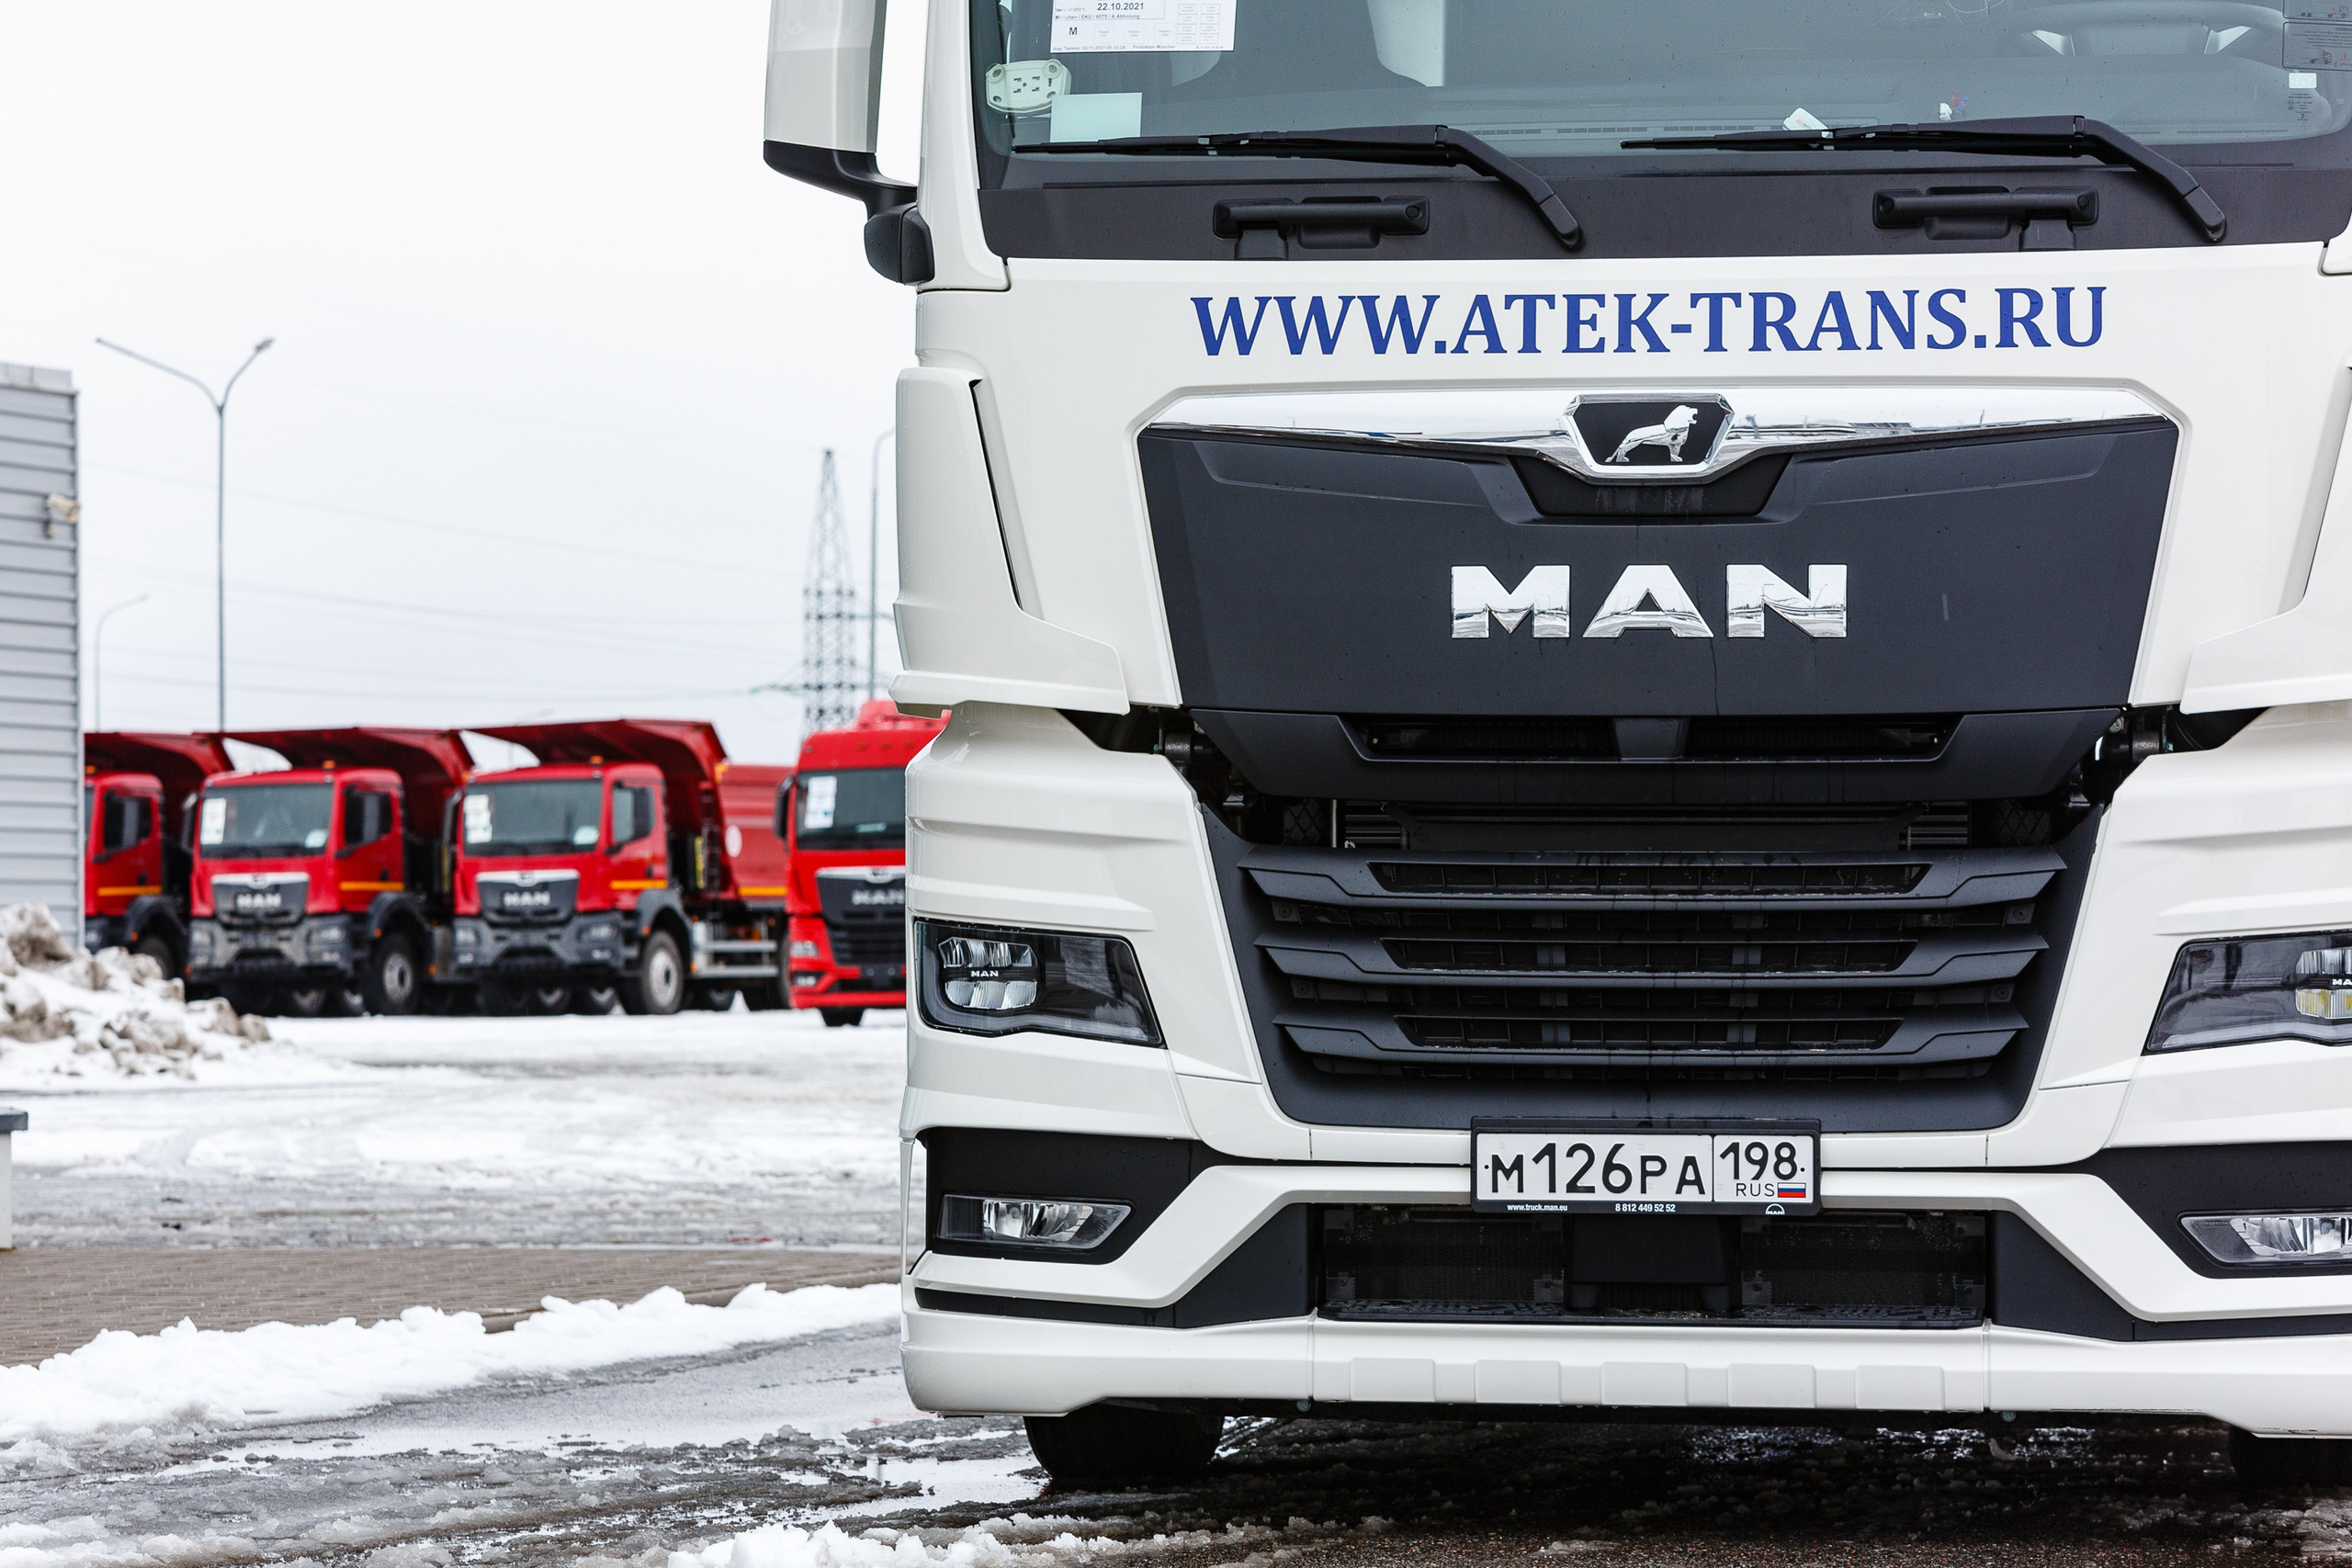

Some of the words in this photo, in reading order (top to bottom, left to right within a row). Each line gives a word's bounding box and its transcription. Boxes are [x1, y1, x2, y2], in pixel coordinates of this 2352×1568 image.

[1069, 27, 1078, 35] M
[1191, 287, 2107, 356] WWW.ATEK-TRANS.RU
[1451, 564, 1848, 638] MAN
[237, 893, 281, 908] MAN
[503, 891, 550, 907] MAN
[1719, 1142, 1798, 1180] 198
[1736, 1182, 1775, 1197] RUS
[1507, 1203, 1568, 1212] www.truck.man.eu
[1615, 1203, 1622, 1212] 8
[1622, 1203, 1636, 1212] 812
[1638, 1203, 1653, 1212] 449
[1654, 1203, 1665, 1213] 52
[1665, 1203, 1676, 1213] 52
